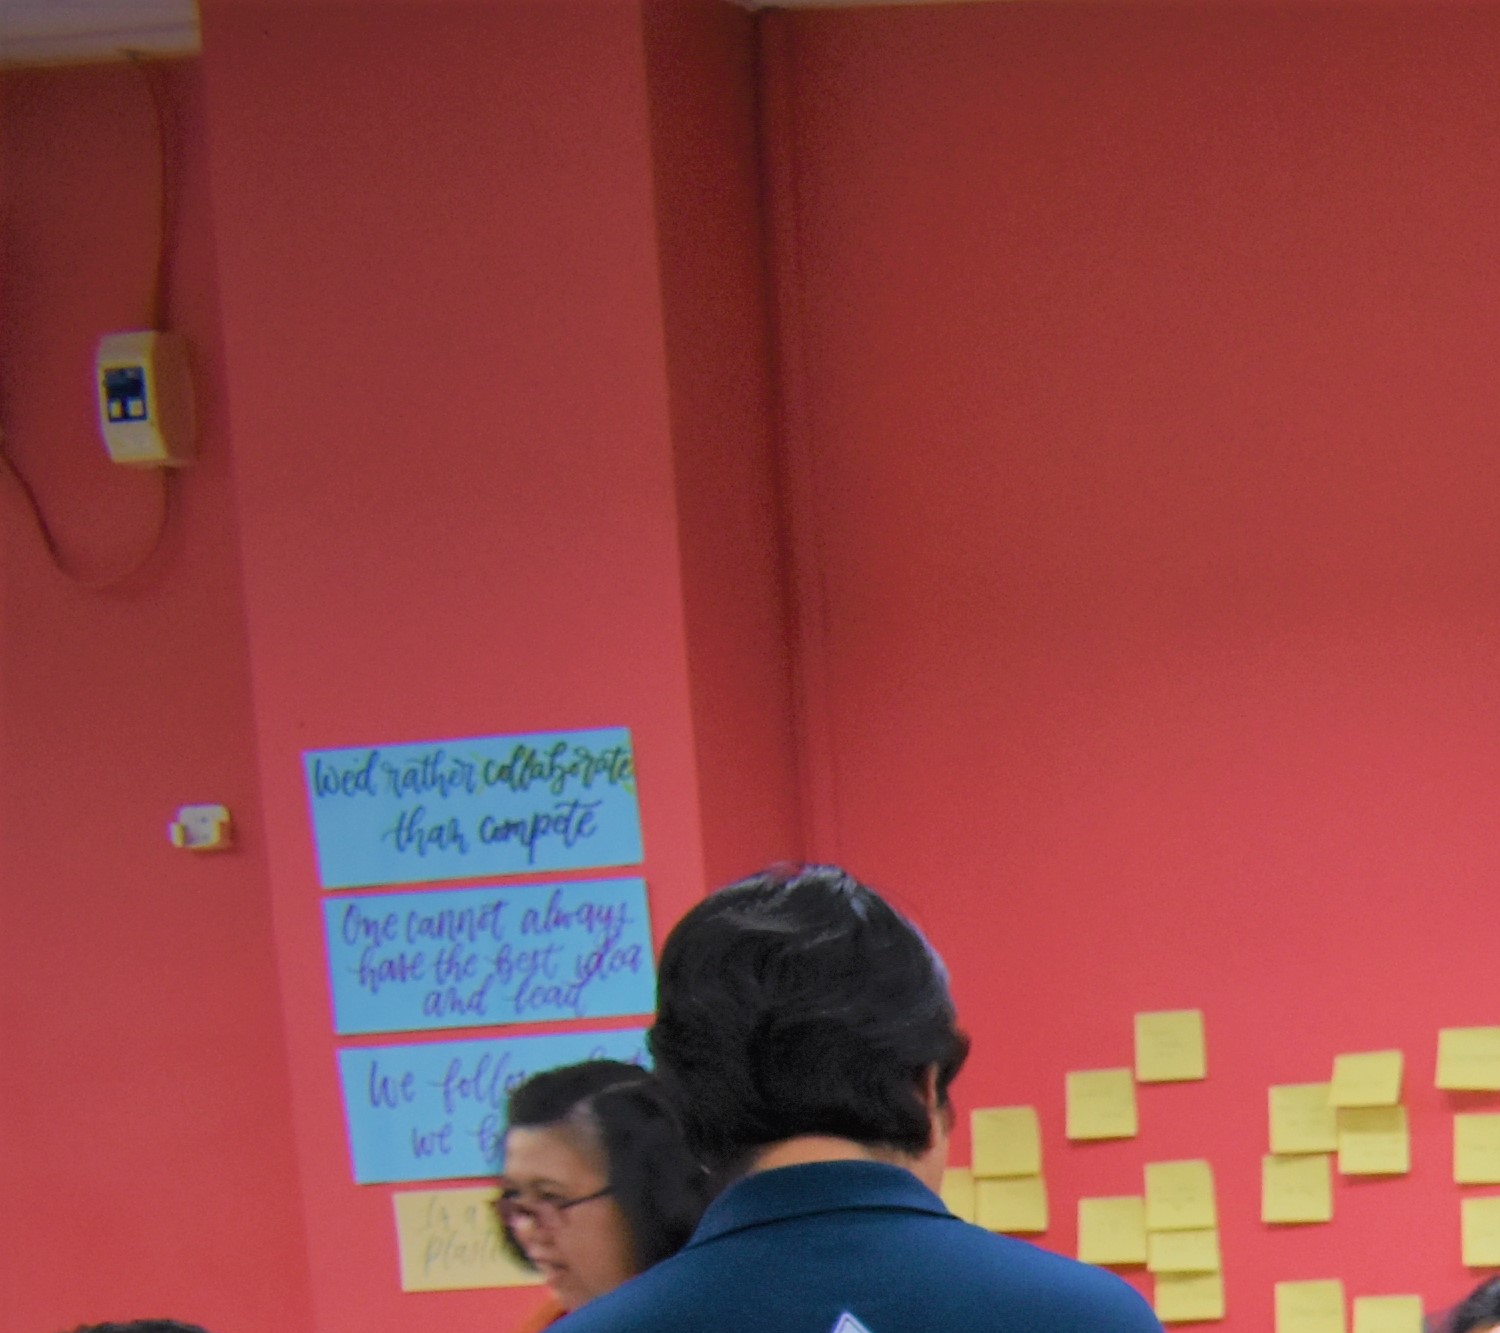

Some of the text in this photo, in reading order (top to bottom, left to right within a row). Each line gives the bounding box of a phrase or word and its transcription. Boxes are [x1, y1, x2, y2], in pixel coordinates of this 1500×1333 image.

[381, 749, 476, 799] rather
[483, 741, 633, 797] collaborate
[382, 801, 602, 865] than compete
[343, 903, 399, 947] One
[407, 900, 509, 944] cannot
[348, 945, 426, 993] have
[434, 944, 478, 985] the
[423, 974, 494, 1017] and
